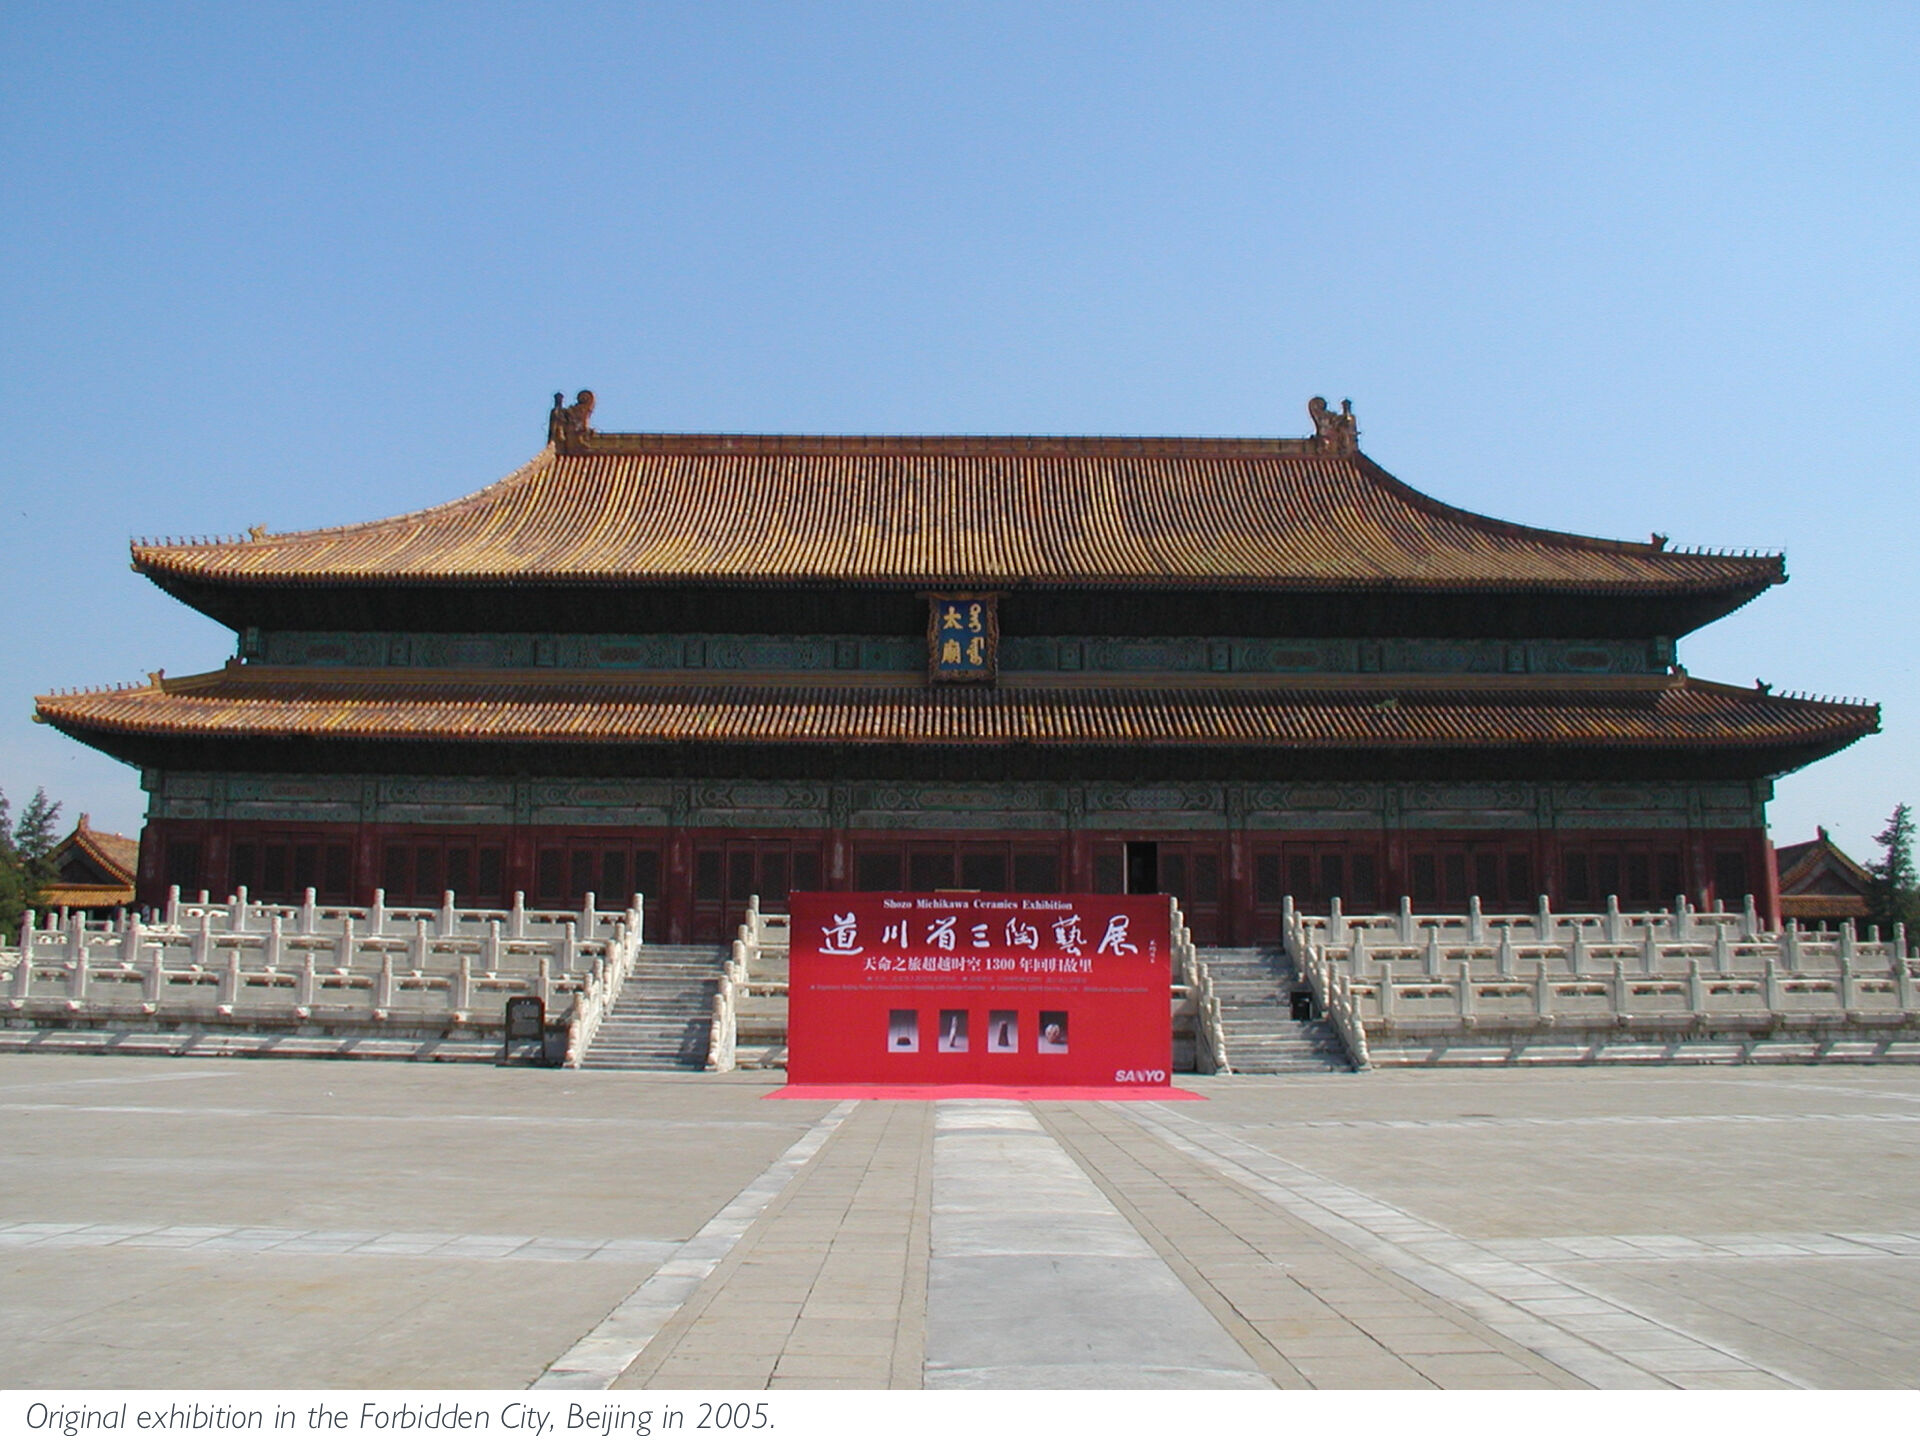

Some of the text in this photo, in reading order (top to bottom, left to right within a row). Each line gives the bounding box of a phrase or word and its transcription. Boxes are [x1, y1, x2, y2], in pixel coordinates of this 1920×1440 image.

[883, 899, 1073, 911] Shozo Michikawa Ceramics Exhibition
[985, 958, 1015, 972] 1300
[1115, 1070, 1166, 1083] SANYO
